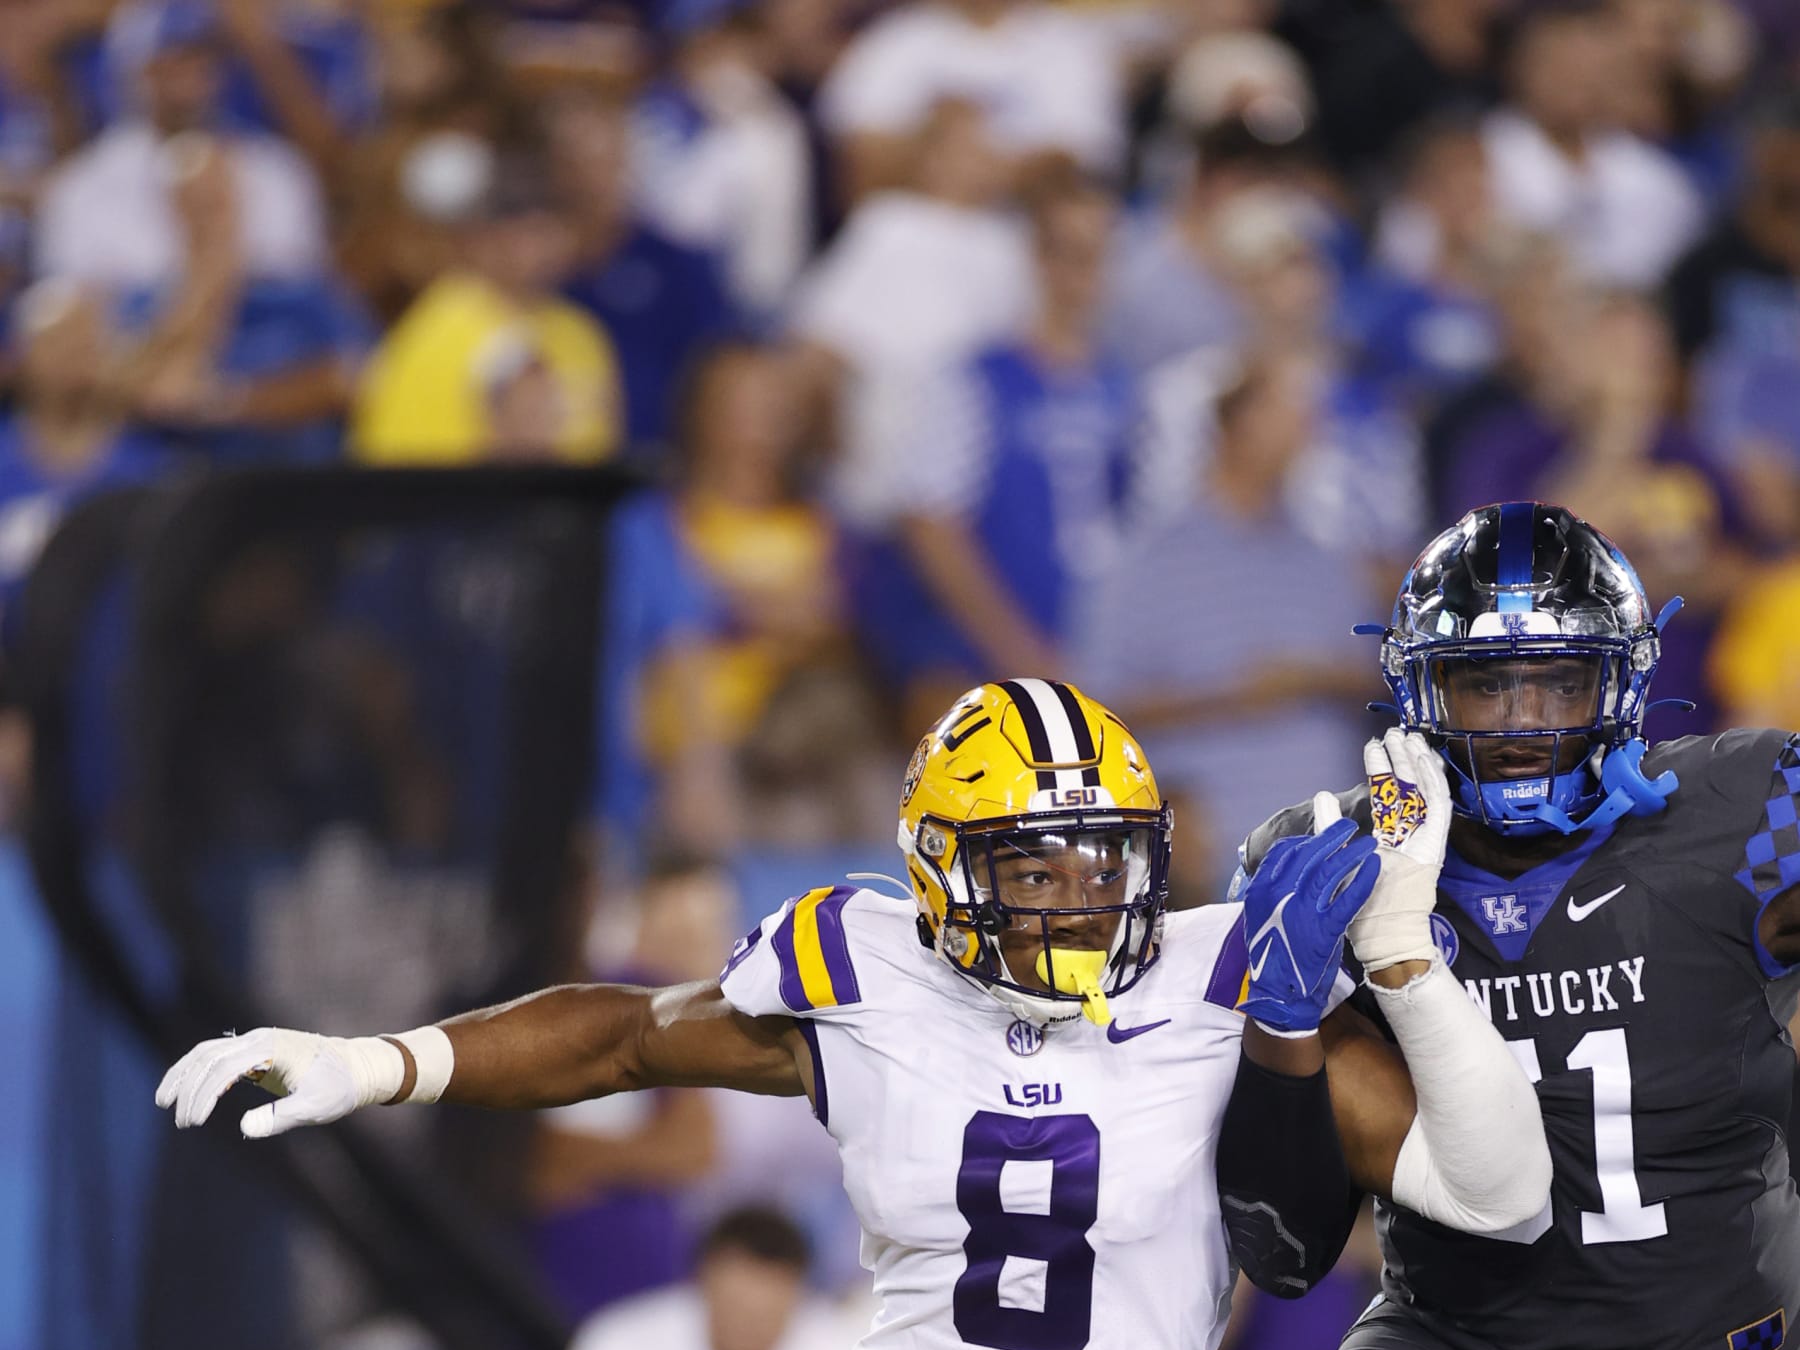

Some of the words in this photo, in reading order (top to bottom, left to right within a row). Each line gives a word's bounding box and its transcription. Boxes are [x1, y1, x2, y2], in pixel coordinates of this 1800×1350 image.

[1050, 788, 1097, 807] LSU
[1503, 783, 1549, 799] Riddell
[1481, 894, 1527, 935] UK
[1465, 956, 1645, 1021] NTUCKY
[1009, 1021, 1043, 1055] SEC
[1003, 1083, 1062, 1107] LSU
